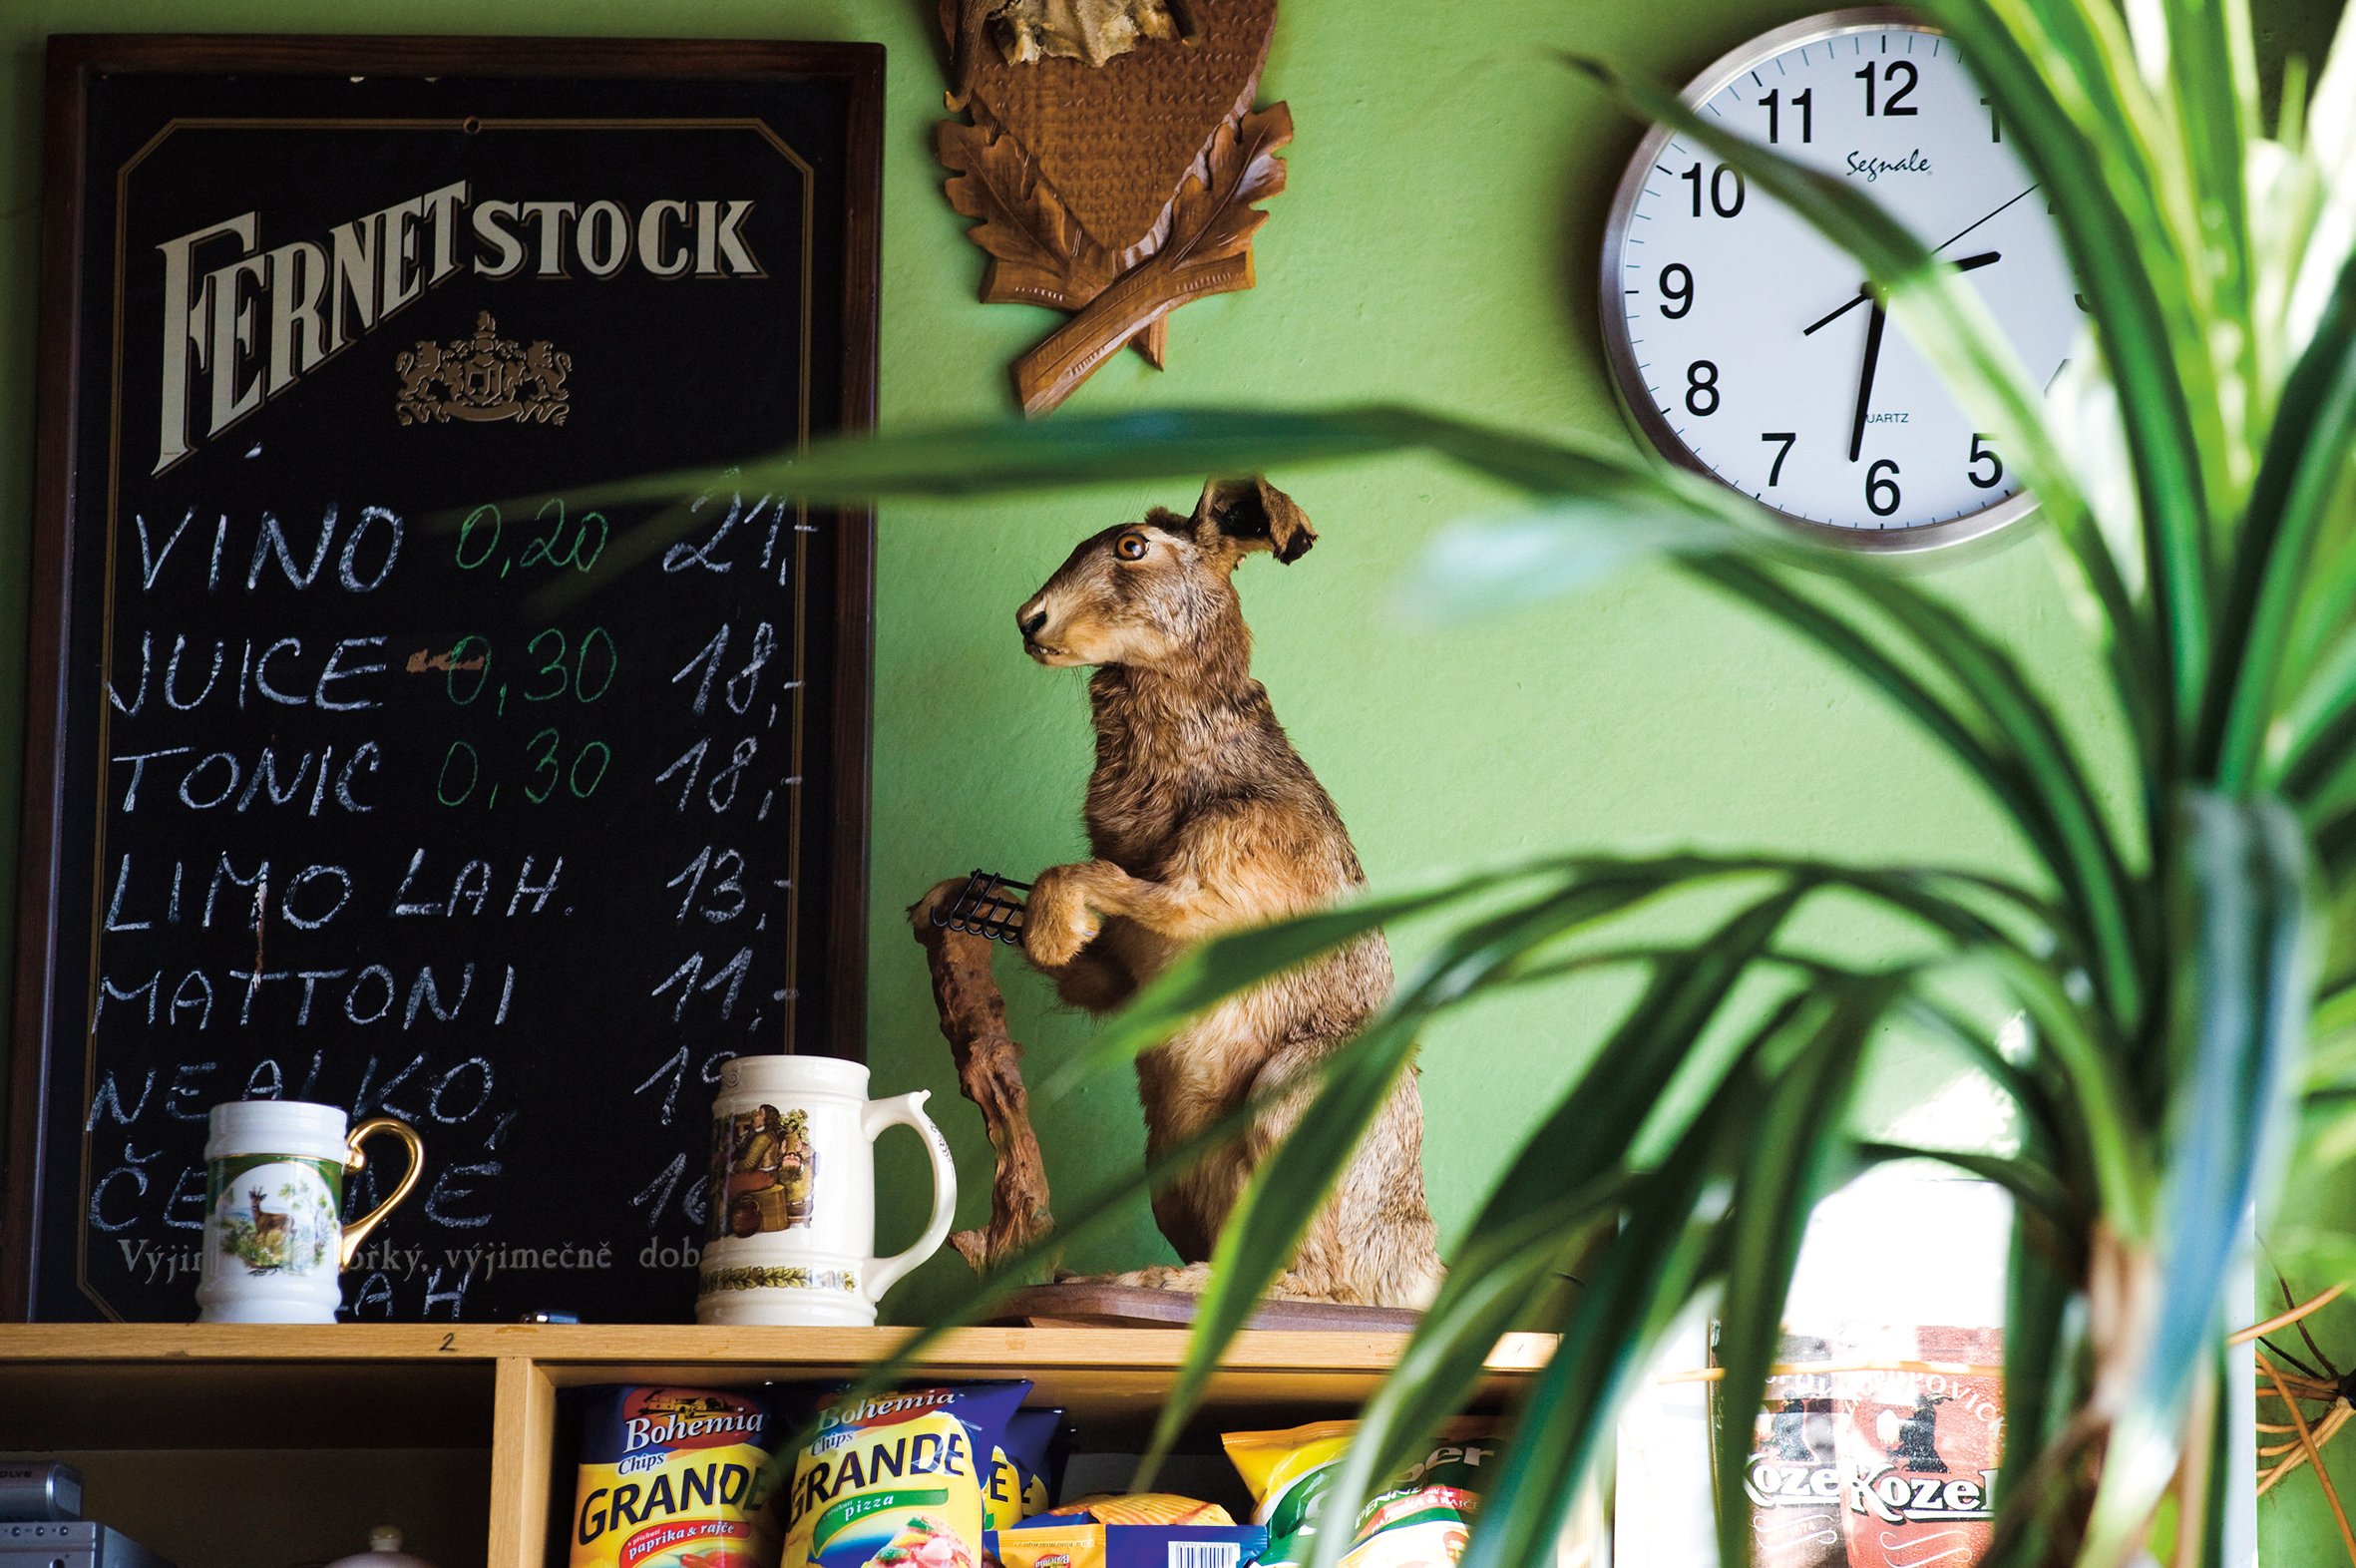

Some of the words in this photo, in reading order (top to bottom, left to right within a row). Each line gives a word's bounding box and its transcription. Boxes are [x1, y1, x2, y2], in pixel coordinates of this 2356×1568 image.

[1759, 88, 1812, 144] 11
[1855, 61, 1919, 117] 12
[1681, 162, 1746, 218] 10
[1846, 149, 1931, 183] Segnale
[1658, 263, 1694, 319] 9
[152, 181, 469, 477] FERNET
[473, 199, 766, 278] STOCK
[1685, 360, 1720, 416] 8
[1866, 413, 1909, 423] UARTZ
[1762, 433, 1795, 487] 7
[1968, 433, 2004, 488] 5
[1865, 460, 1901, 517] 6
[137, 504, 402, 592] VINO
[456, 499, 607, 578] 0,20
[106, 630, 387, 716] JUICE
[113, 741, 381, 816] TONIC
[437, 728, 610, 810] 0,30
[105, 850, 352, 932] LIMO
[91, 964, 514, 1033] MATTONI
[347, 1239, 428, 1283] ořký,
[445, 1240, 611, 1283] výjimečně
[622, 1406, 764, 1453] Bohemia
[817, 1389, 956, 1432] Bohemia
[617, 1451, 665, 1476] Chips
[811, 1430, 855, 1457] Chips
[579, 1462, 768, 1546] GRANDE
[845, 1494, 894, 1522] pizza
[629, 1529, 685, 1561] paprika
[686, 1526, 697, 1537] &
[700, 1520, 735, 1537] rajče
